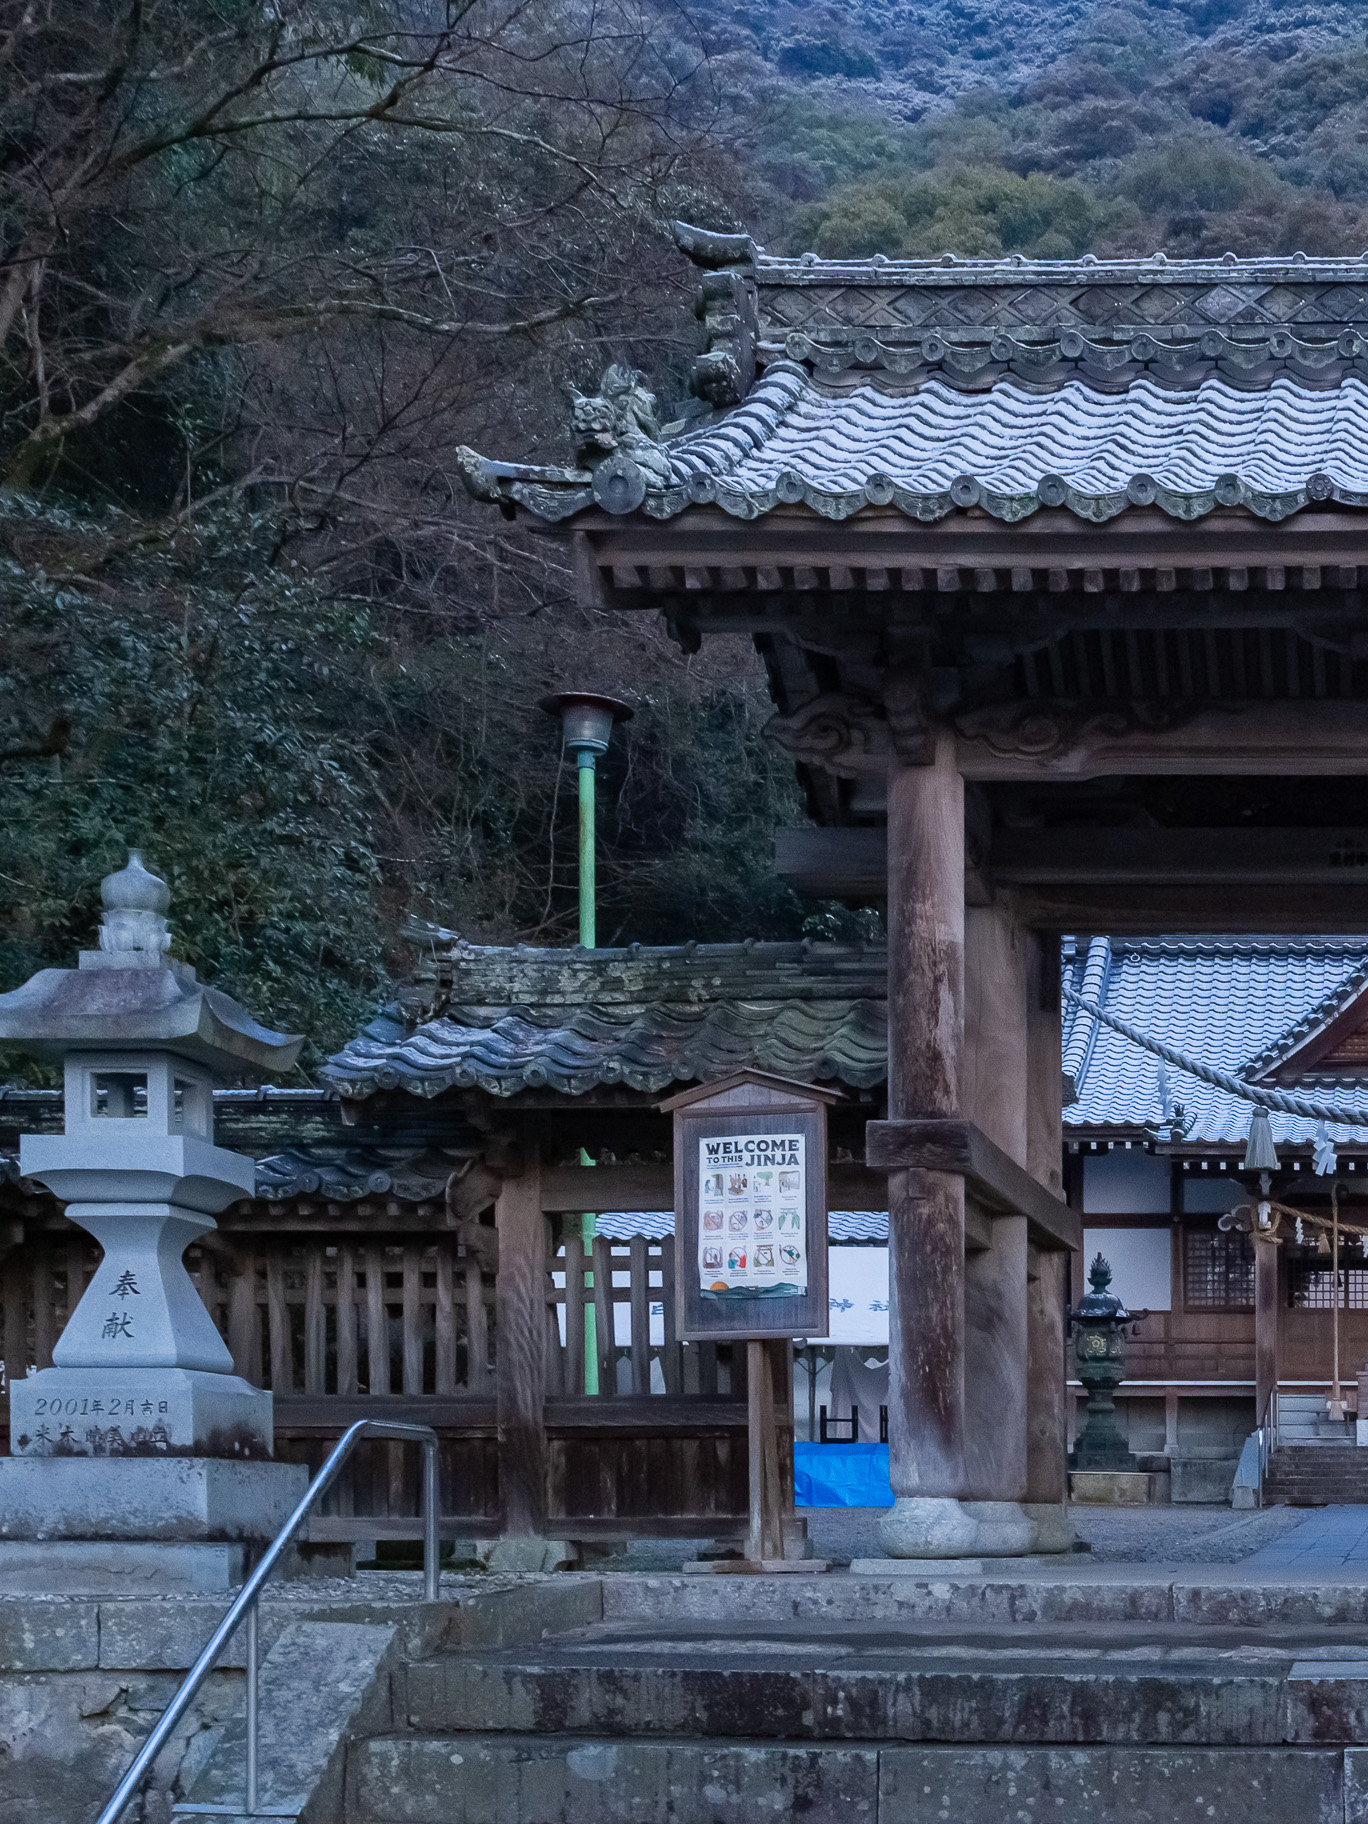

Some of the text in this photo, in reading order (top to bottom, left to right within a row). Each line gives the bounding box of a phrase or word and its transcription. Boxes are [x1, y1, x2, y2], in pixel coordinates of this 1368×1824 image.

[705, 1139, 800, 1156] WELCOME
[706, 1156, 720, 1164] TO
[721, 1154, 743, 1164] THIS
[745, 1153, 800, 1167] JINJA
[102, 1269, 141, 1339] 奉献
[34, 1397, 169, 1417] 2001年2月吉日
